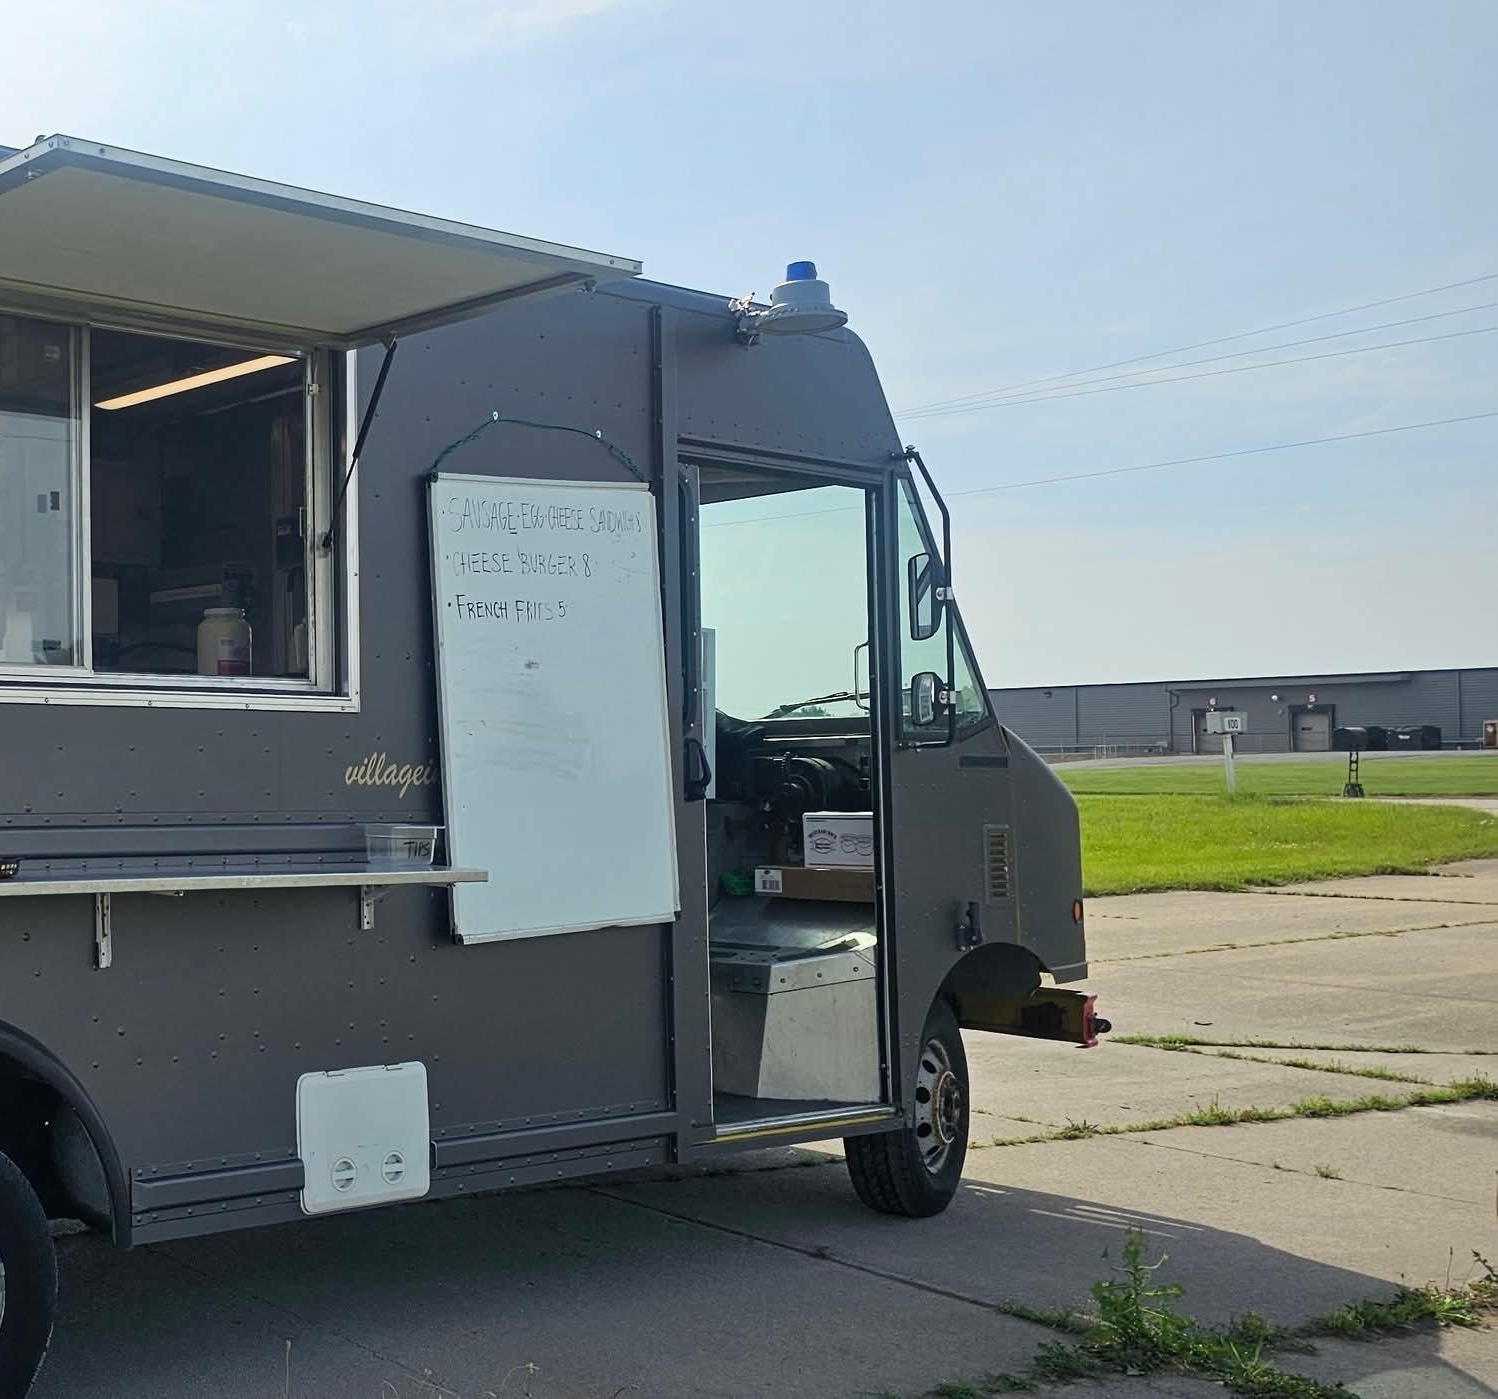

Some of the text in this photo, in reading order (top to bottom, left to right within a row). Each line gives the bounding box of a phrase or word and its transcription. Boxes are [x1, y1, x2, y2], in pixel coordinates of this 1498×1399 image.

[453, 550, 592, 578] CHEESE BURGER 8
[456, 594, 508, 620] FRENCH
[558, 600, 567, 618] 5
[404, 840, 431, 859] TIPS
